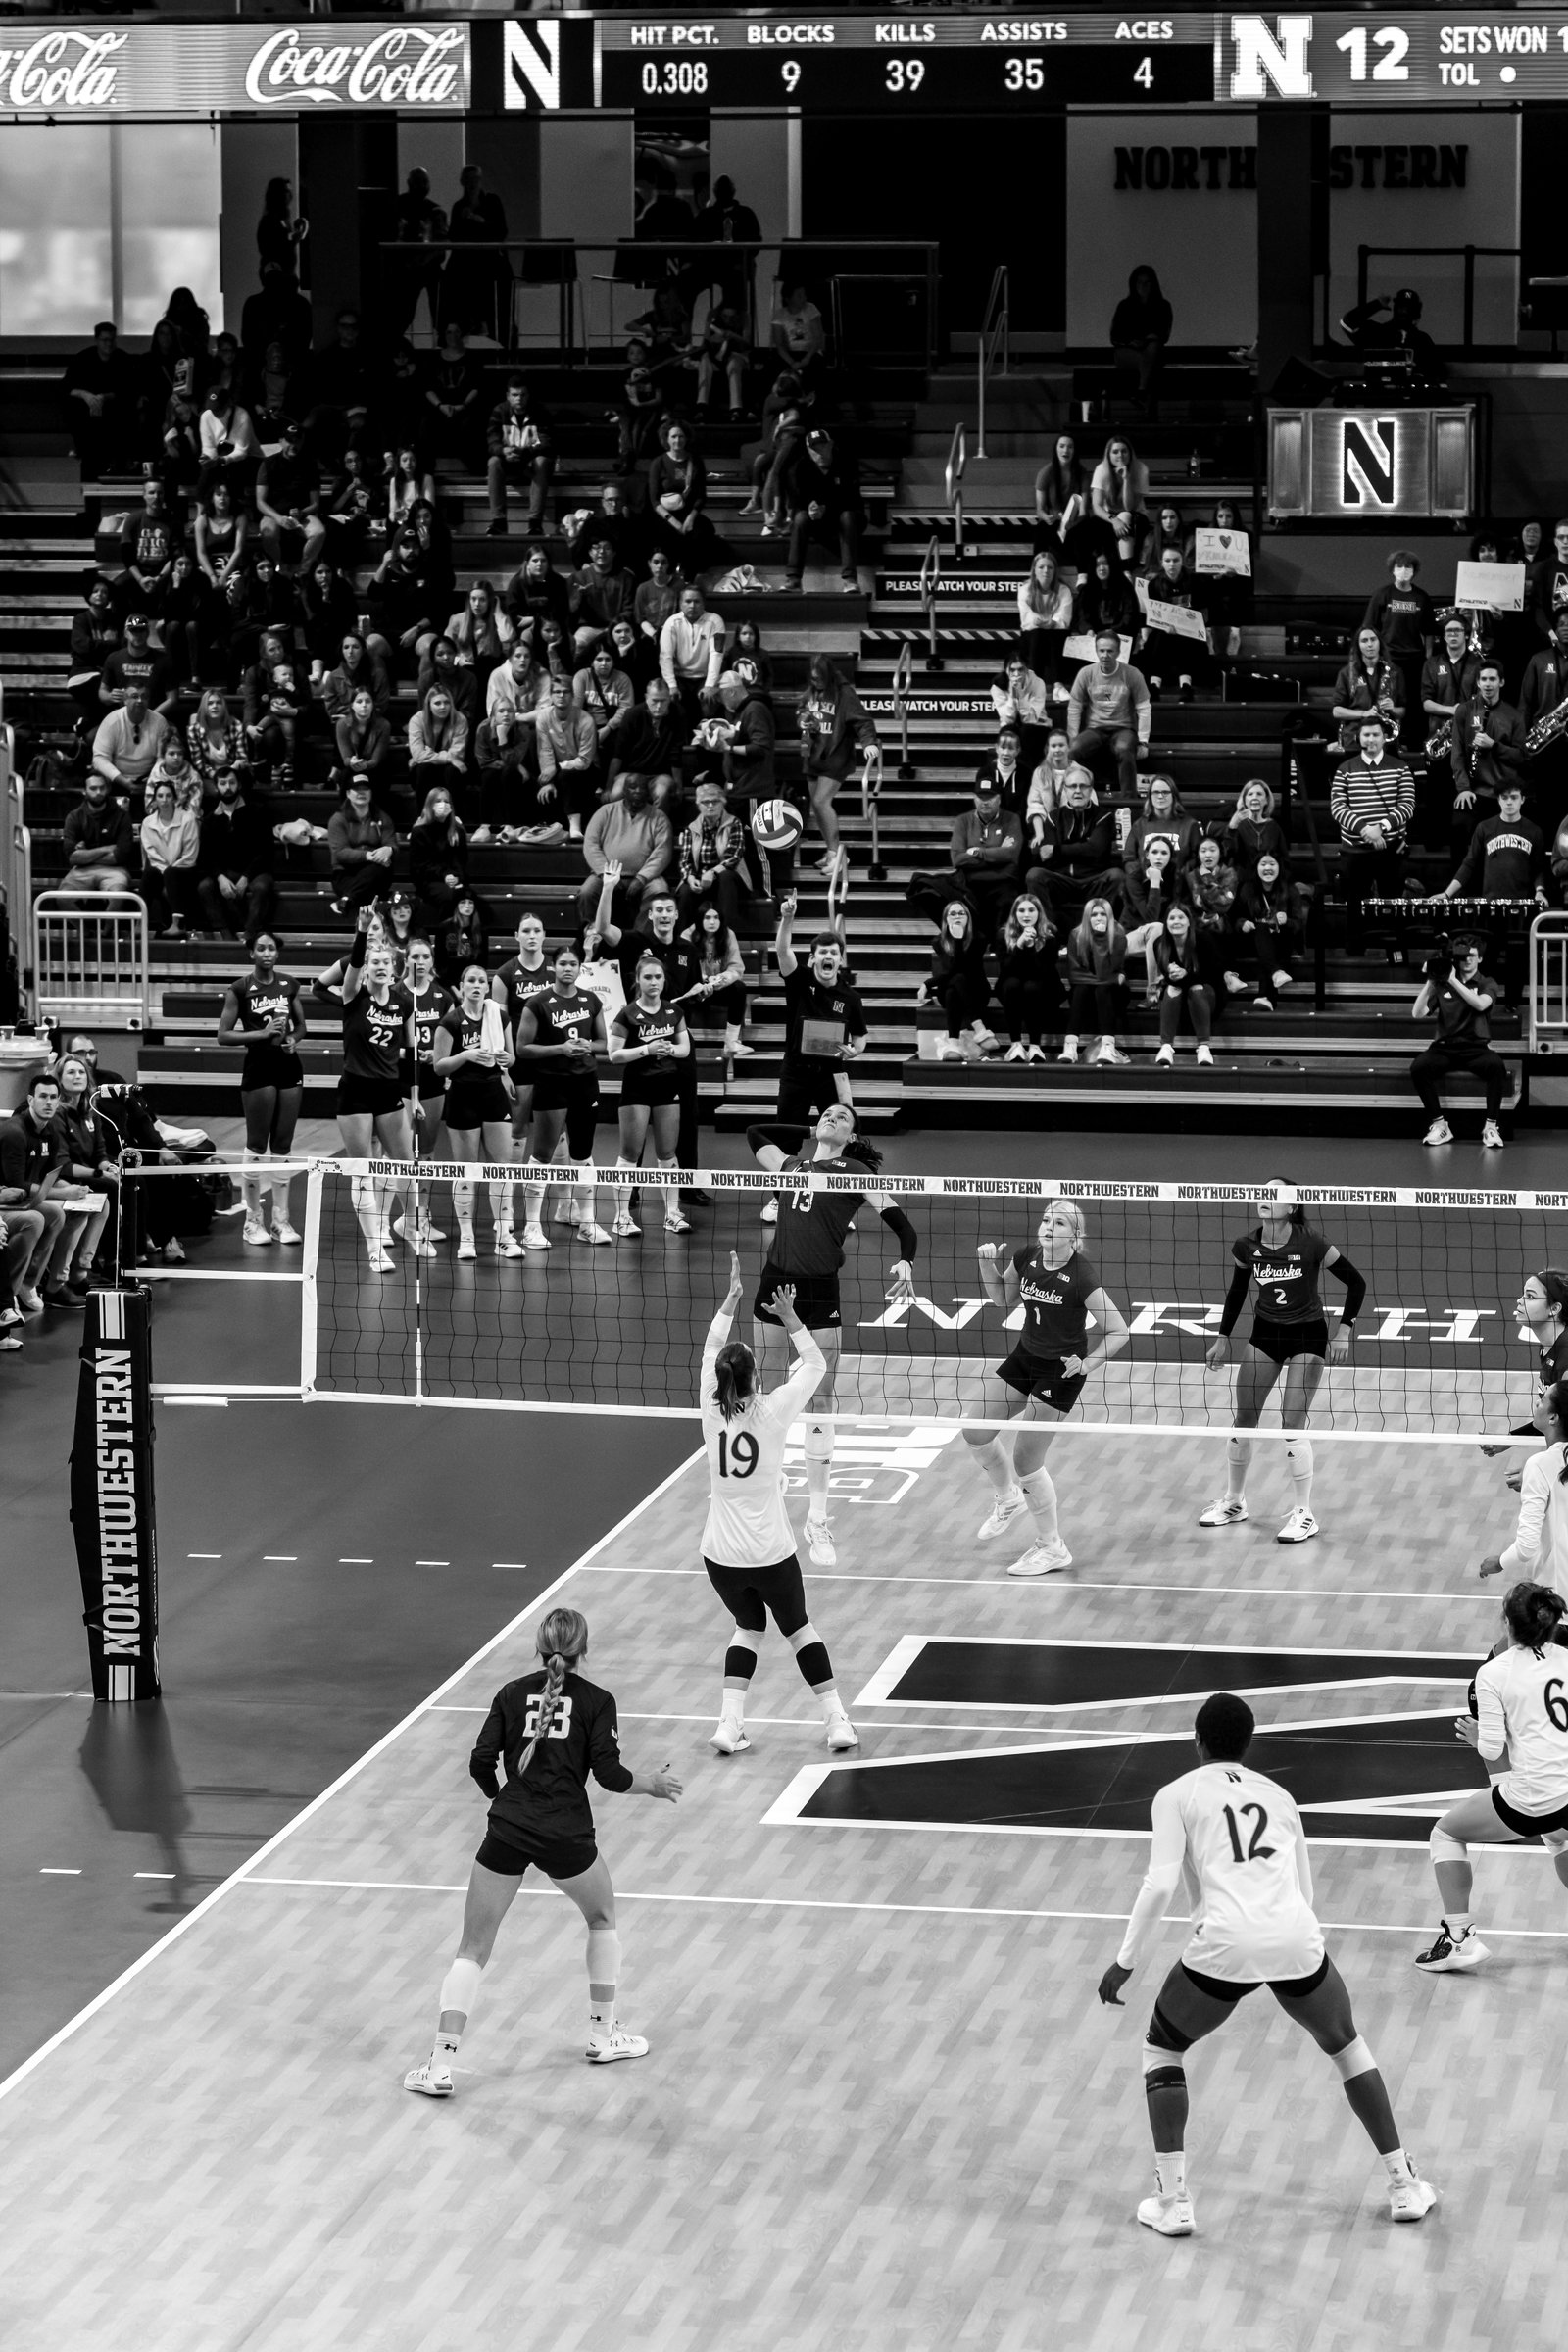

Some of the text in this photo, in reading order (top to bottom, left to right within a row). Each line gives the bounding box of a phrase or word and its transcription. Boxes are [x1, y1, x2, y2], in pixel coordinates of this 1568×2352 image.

[631, 25, 720, 45] HIT PCT.
[747, 24, 835, 43] BLOCKS
[875, 24, 936, 42] KILLS
[981, 22, 1067, 41] ASSISTS
[1114, 21, 1174, 40] ACES
[1439, 26, 1491, 53] SETS
[1494, 26, 1547, 53] WON
[1231, 15, 1313, 98] N
[1336, 26, 1410, 80] 12
[245, 28, 464, 103] Coca-Cola
[504, 20, 560, 109] N
[1004, 58, 1044, 90] 35
[1134, 57, 1153, 88] 4
[1439, 63, 1481, 85] TOL
[642, 62, 708, 94] 0.308
[782, 61, 801, 92] 9
[885, 60, 925, 91] 39
[1114, 144, 1468, 189] NORTHSTERN
[1344, 418, 1396, 507] N
[966, 581, 996, 592] YOUR
[940, 701, 969, 711] YOUR
[251, 995, 288, 1010] Nebraska
[367, 1005, 403, 1023] Nebraska
[552, 1007, 590, 1024] Nebraska
[369, 1026, 393, 1047] 22
[638, 1024, 674, 1038] Nebraska
[368, 1161, 466, 1178] NORTHWESTERN
[482, 1166, 579, 1182] NORTHWESTERN
[596, 1170, 694, 1186] NORTHWESTERN
[711, 1173, 809, 1188] NORTHWESTERN
[827, 1176, 925, 1191] NORTHWESTERN
[943, 1179, 1042, 1195] NORTHWESTERN
[1060, 1182, 1159, 1198] NORTHWESTERN
[792, 1191, 813, 1213] 13
[1178, 1185, 1278, 1200] NORTHWESTERN
[1296, 1188, 1396, 1203] NORTHWESTERN
[1415, 1191, 1517, 1206] NORTHWESTERN
[1253, 1263, 1302, 1279] Nebraska
[1020, 1276, 1063, 1303] Nebraska
[1274, 1288, 1288, 1304] 2
[1034, 1306, 1041, 1325] 1
[718, 1430, 760, 1479] 19
[95, 1347, 140, 1656] NORTHWESTERN
[1544, 1678, 1568, 1733] 6
[522, 1693, 573, 1740] 23
[1223, 1802, 1277, 1862] 12
